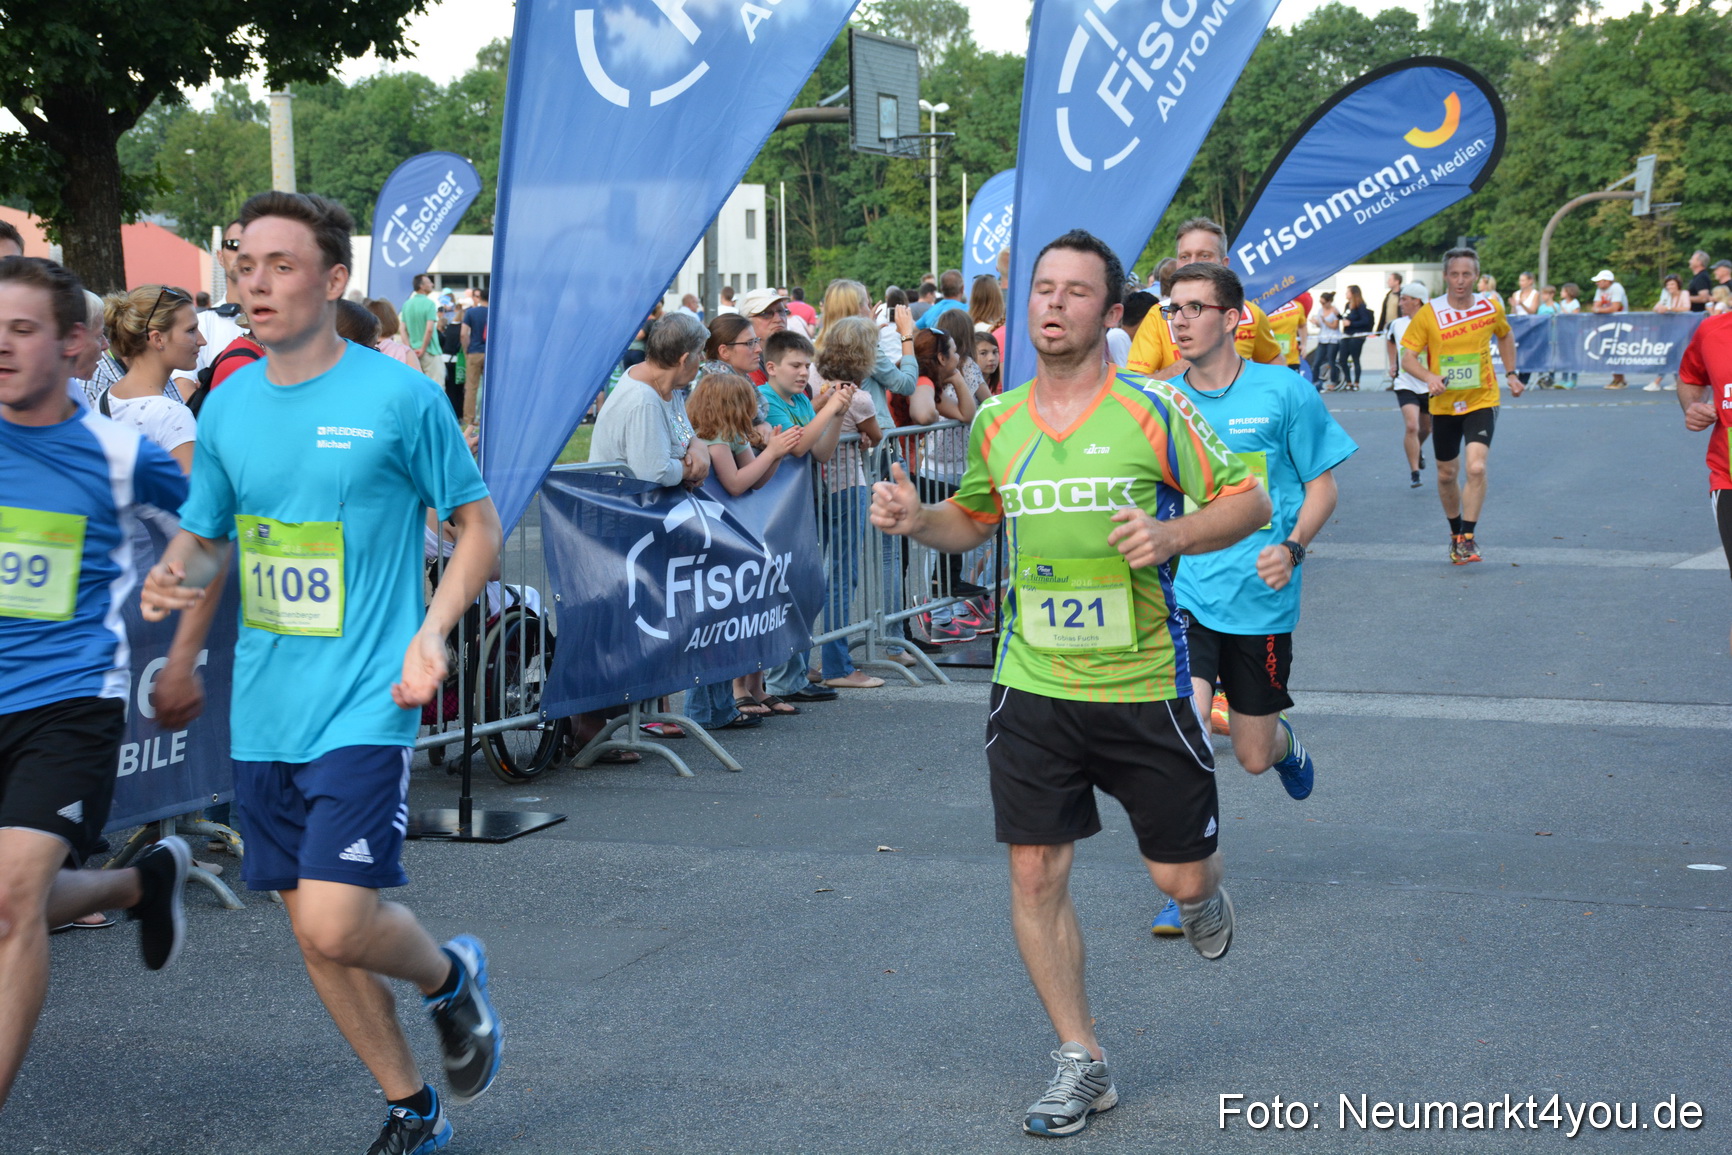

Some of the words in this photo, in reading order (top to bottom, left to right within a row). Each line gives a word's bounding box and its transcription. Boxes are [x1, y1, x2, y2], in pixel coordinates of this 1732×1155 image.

[1096, 0, 1198, 128] Fisc
[1156, 0, 1236, 123] AUTOM
[1353, 191, 1399, 225] Druck
[1400, 175, 1430, 198] und
[1430, 138, 1487, 182] Medien
[396, 170, 457, 254] Fischer
[418, 186, 464, 253] AUTOMOBILE
[1236, 154, 1421, 276] Frischmann
[1250, 273, 1296, 305] n-net.de
[1440, 326, 1469, 341] MAX
[1599, 337, 1674, 357] Fischer
[1447, 367, 1473, 380] 850
[1605, 356, 1667, 366] AUTOMOBILE
[326, 426, 375, 439] PFLEIDERER
[1143, 378, 1234, 467] BOCK
[1229, 427, 1256, 435] Thomas
[1235, 416, 1270, 425] PFLEIDERER
[317, 439, 352, 450] Michael
[998, 477, 1138, 519] BOCK
[0, 551, 50, 588] 99
[251, 561, 331, 604] 1108
[683, 602, 793, 653] AUTOMOBILE
[1040, 597, 1105, 628] 121
